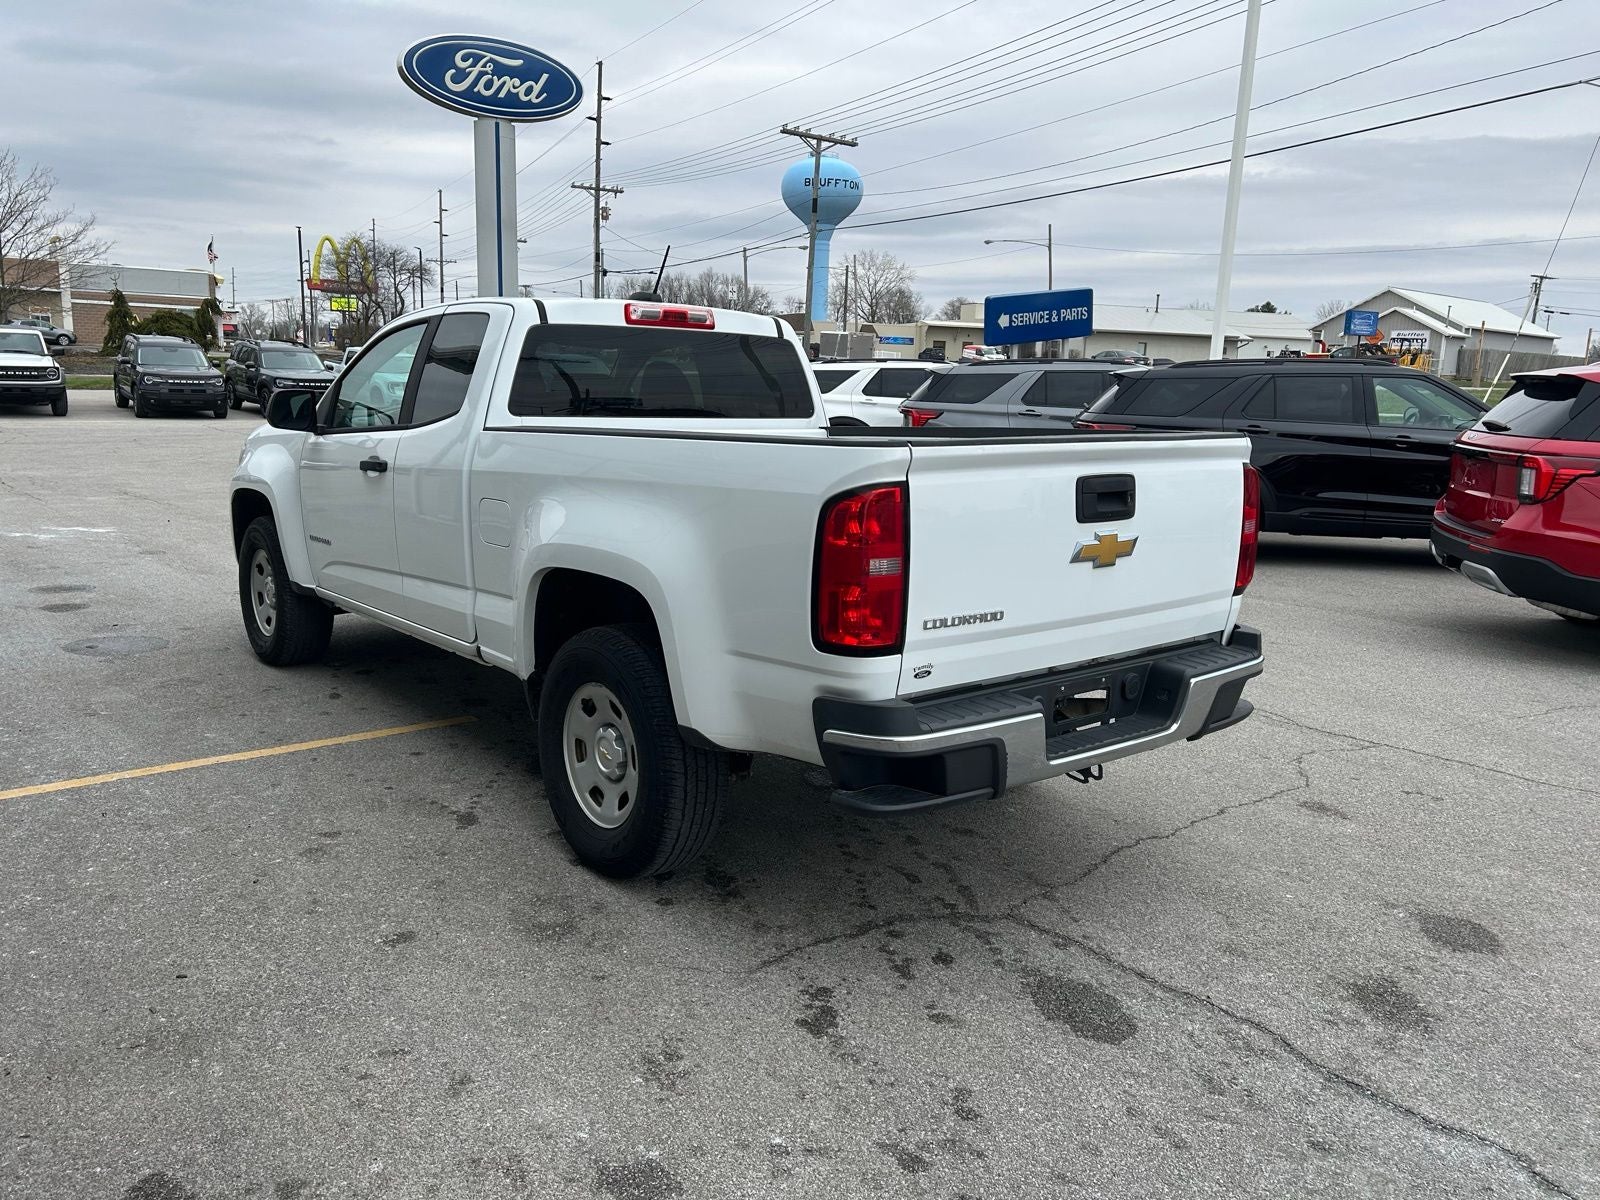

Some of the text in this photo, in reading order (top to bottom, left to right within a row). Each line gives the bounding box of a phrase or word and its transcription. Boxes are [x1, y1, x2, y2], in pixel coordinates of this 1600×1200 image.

[444, 49, 549, 104] Ford
[1011, 306, 1088, 326] SERVICE & PARTS
[922, 610, 1005, 630] COLORADO
[913, 662, 934, 673] Family
